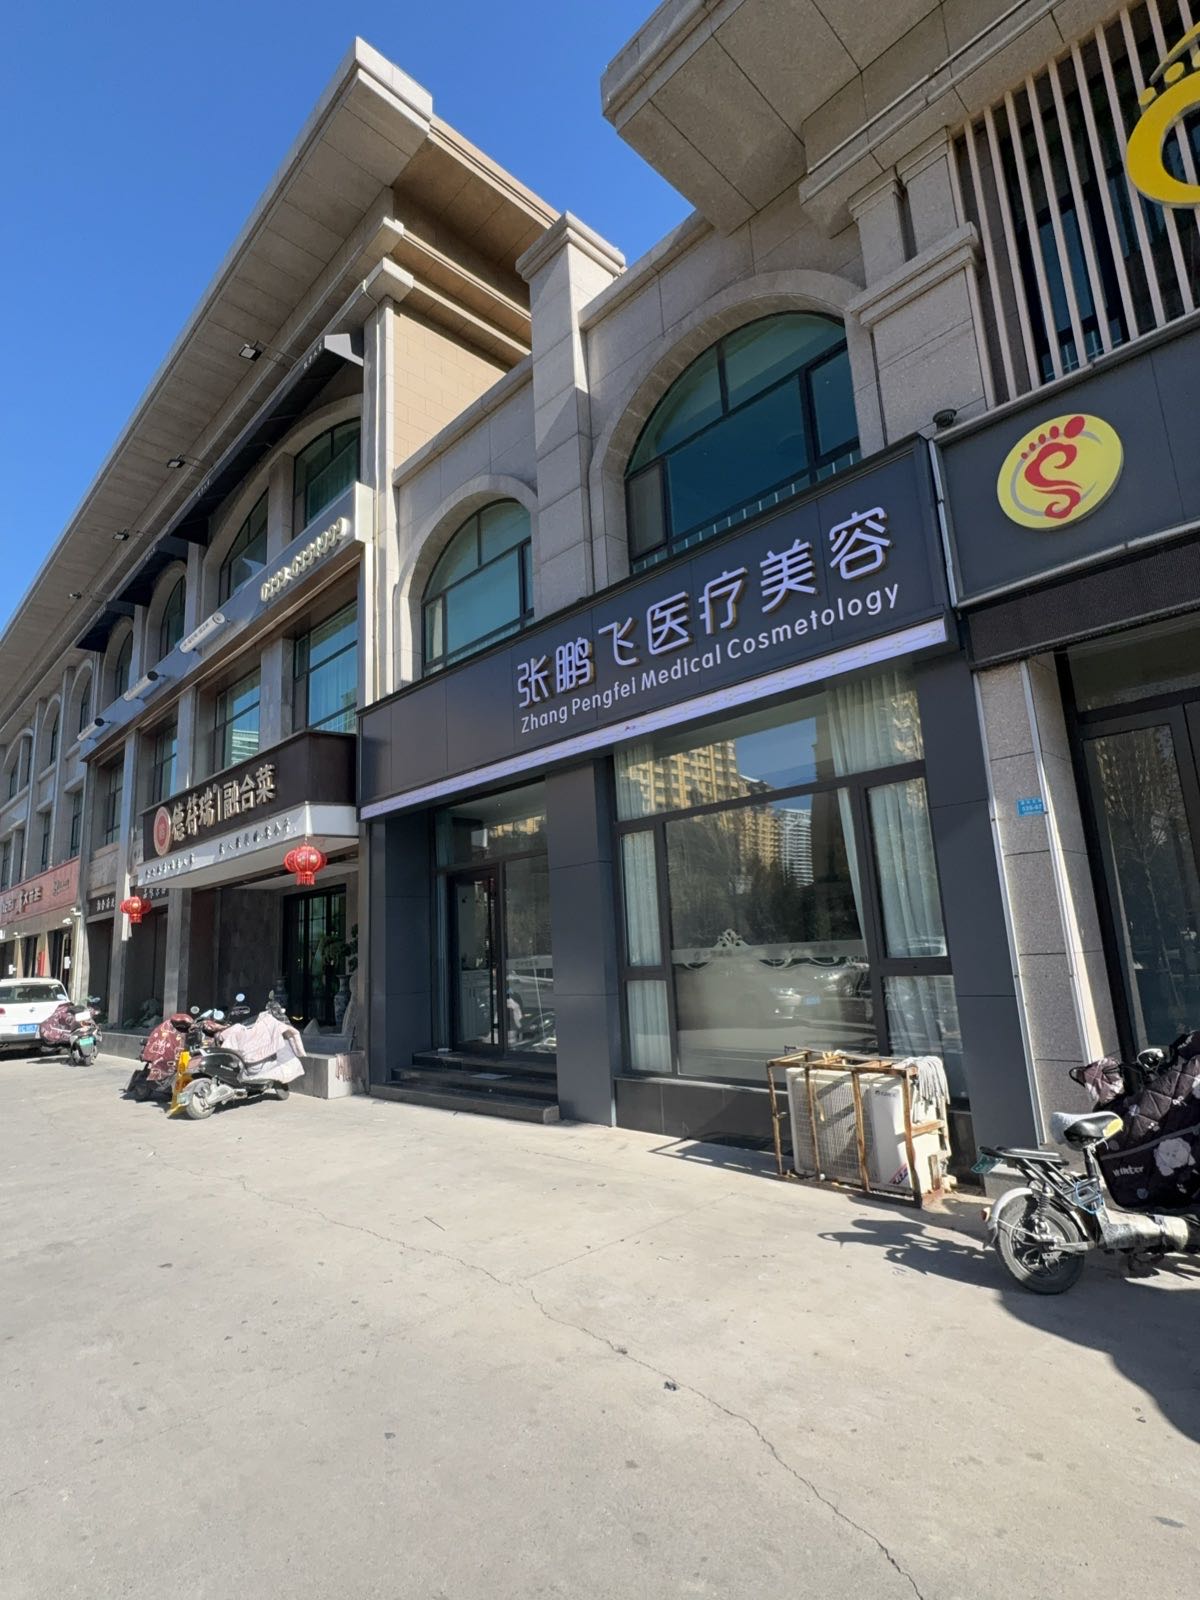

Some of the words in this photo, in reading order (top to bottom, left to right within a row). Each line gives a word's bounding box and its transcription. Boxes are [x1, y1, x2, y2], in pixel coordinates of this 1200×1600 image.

[517, 506, 892, 708] 张鹏飞医疗美容
[521, 700, 568, 734] Zhang
[571, 677, 636, 716] Pengfei
[641, 644, 721, 691] Medical
[727, 583, 899, 659] Cosmetology
[223, 764, 276, 820] 融合菜
